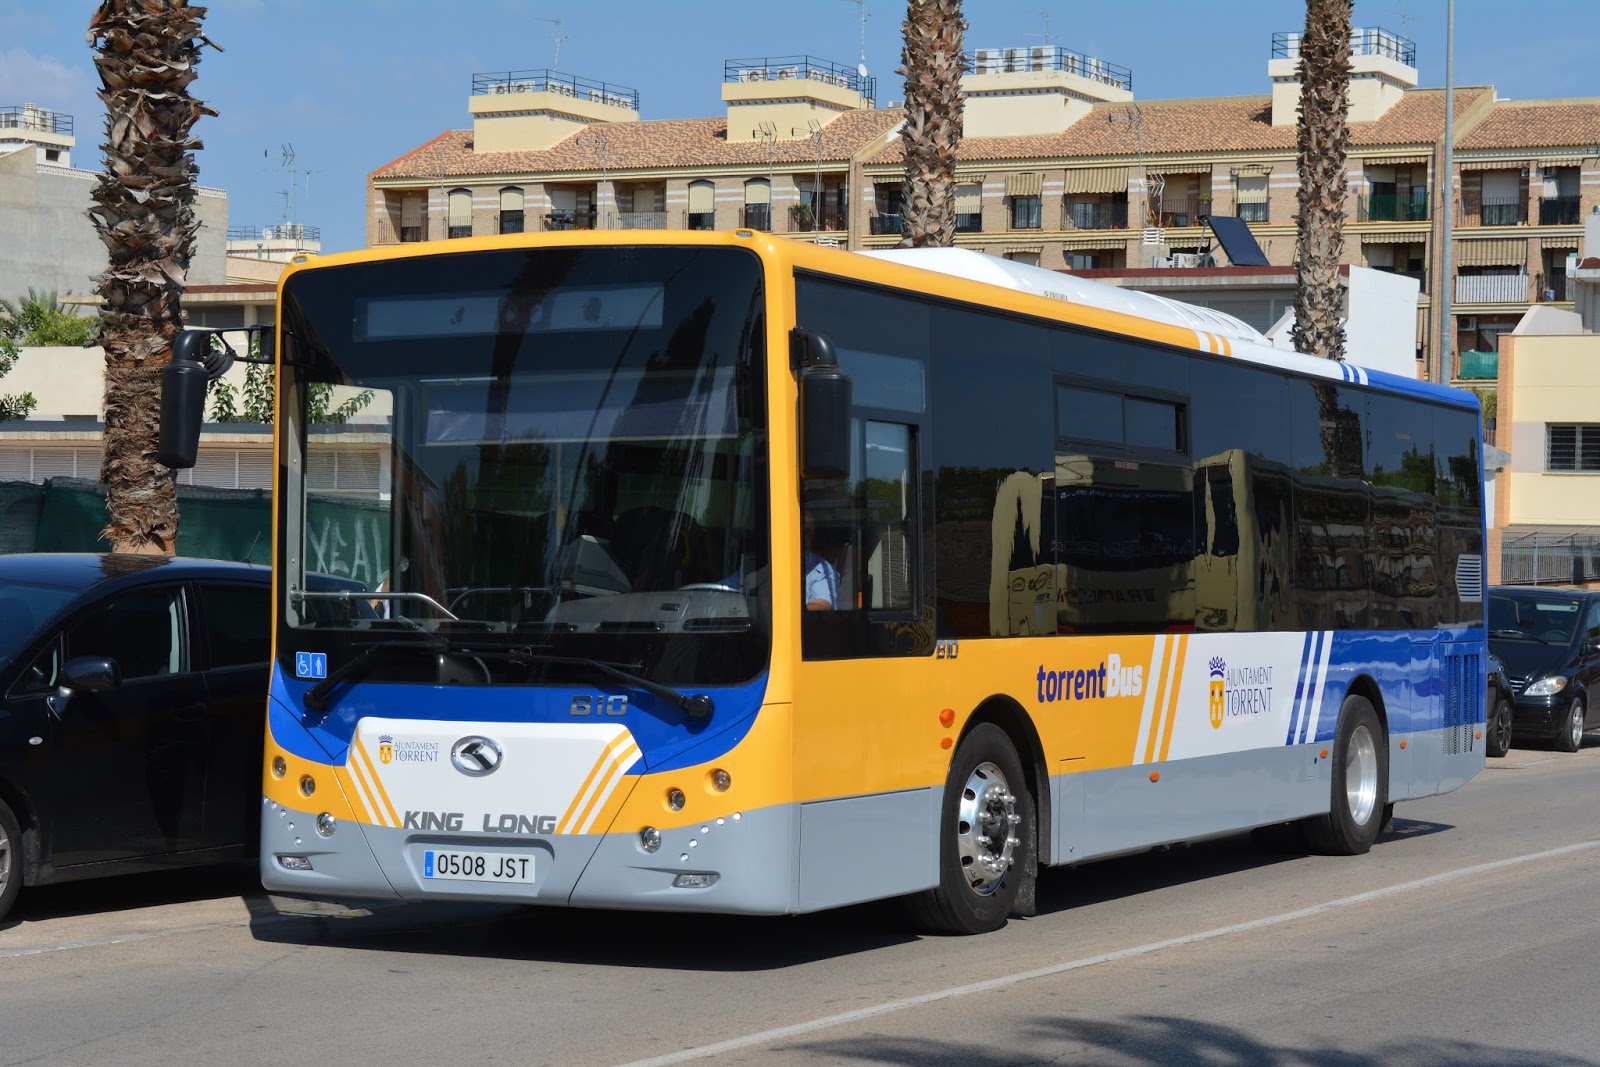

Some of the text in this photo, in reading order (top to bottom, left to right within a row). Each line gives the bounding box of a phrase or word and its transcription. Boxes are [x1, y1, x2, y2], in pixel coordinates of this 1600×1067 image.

[1226, 666, 1273, 689] AJUNTAMENT
[1226, 687, 1273, 716] TORRENT
[394, 741, 439, 751] AJUNTAMENT
[394, 750, 440, 762] TORRENT
[403, 810, 557, 835] KING LONG
[437, 854, 485, 876] 0508
[492, 857, 529, 879] JST
